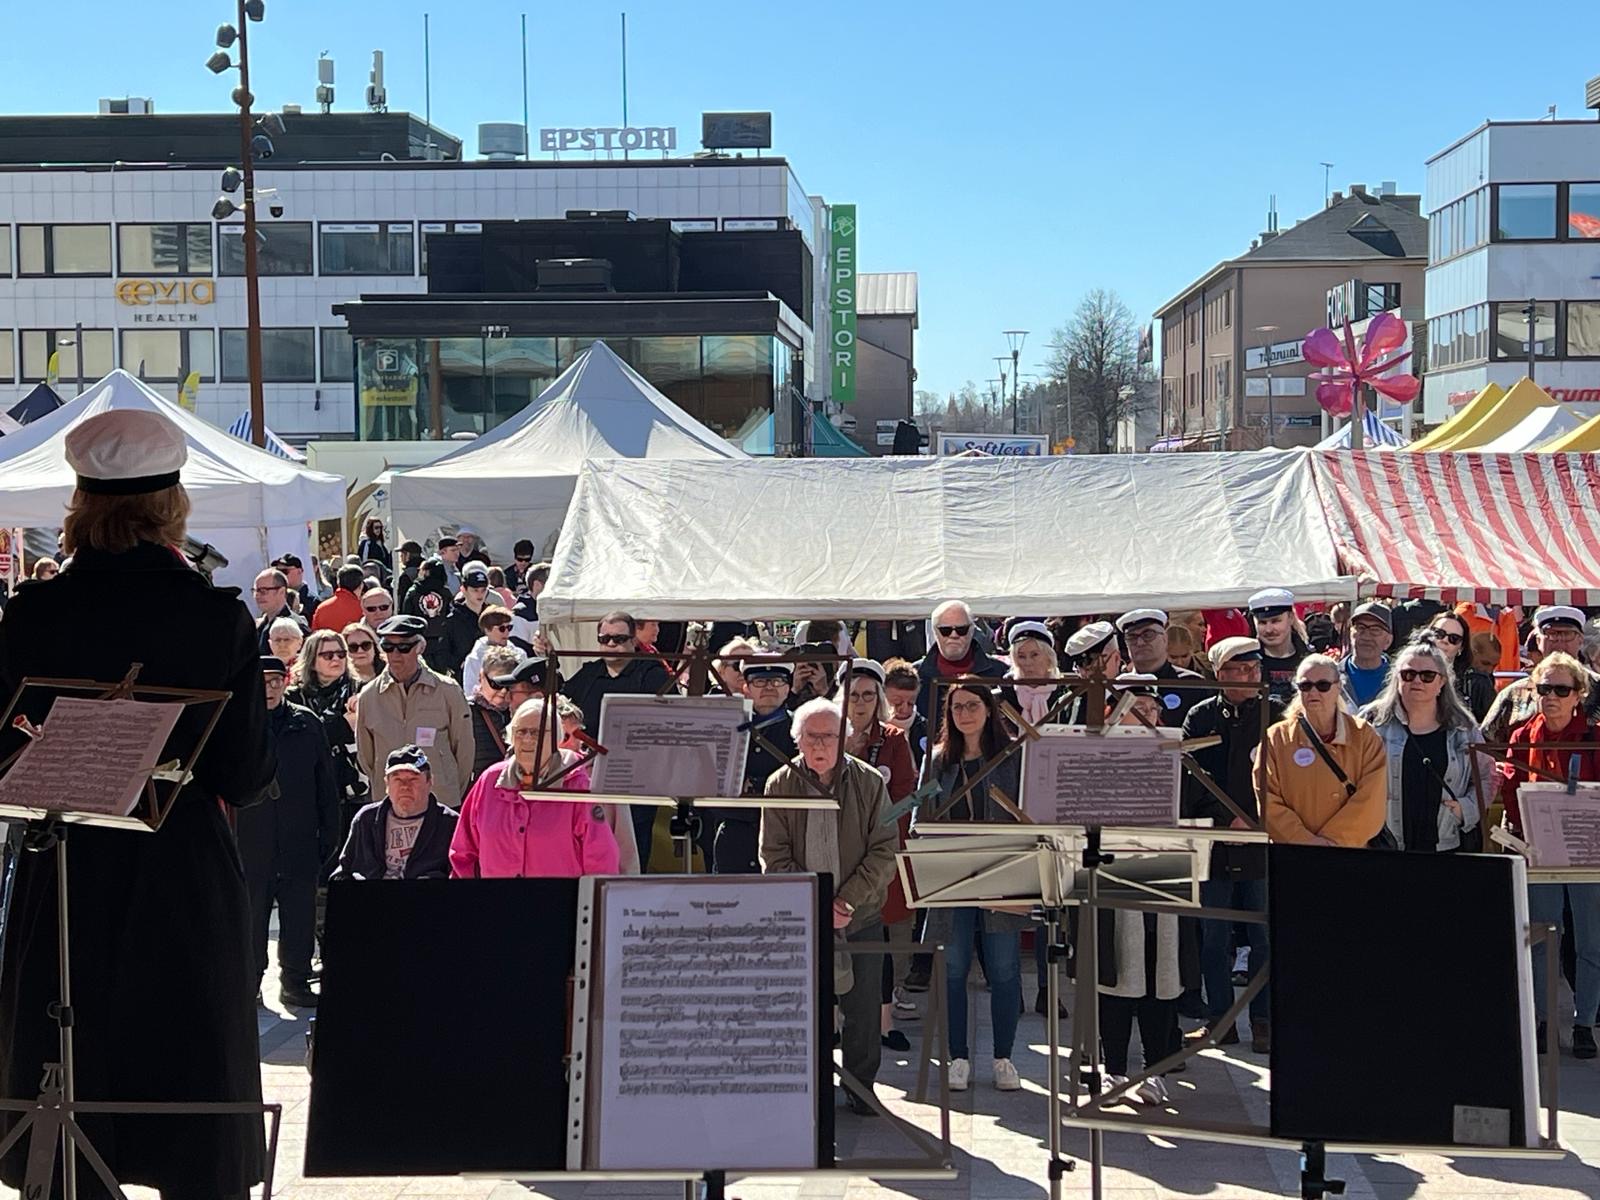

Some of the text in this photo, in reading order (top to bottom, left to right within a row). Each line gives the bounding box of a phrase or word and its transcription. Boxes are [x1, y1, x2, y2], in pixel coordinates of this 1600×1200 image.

[540, 127, 676, 150] EPSTORI
[134, 314, 198, 322] HEALTH
[835, 248, 853, 388] EPSTORI
[1326, 279, 1355, 330] FORUM
